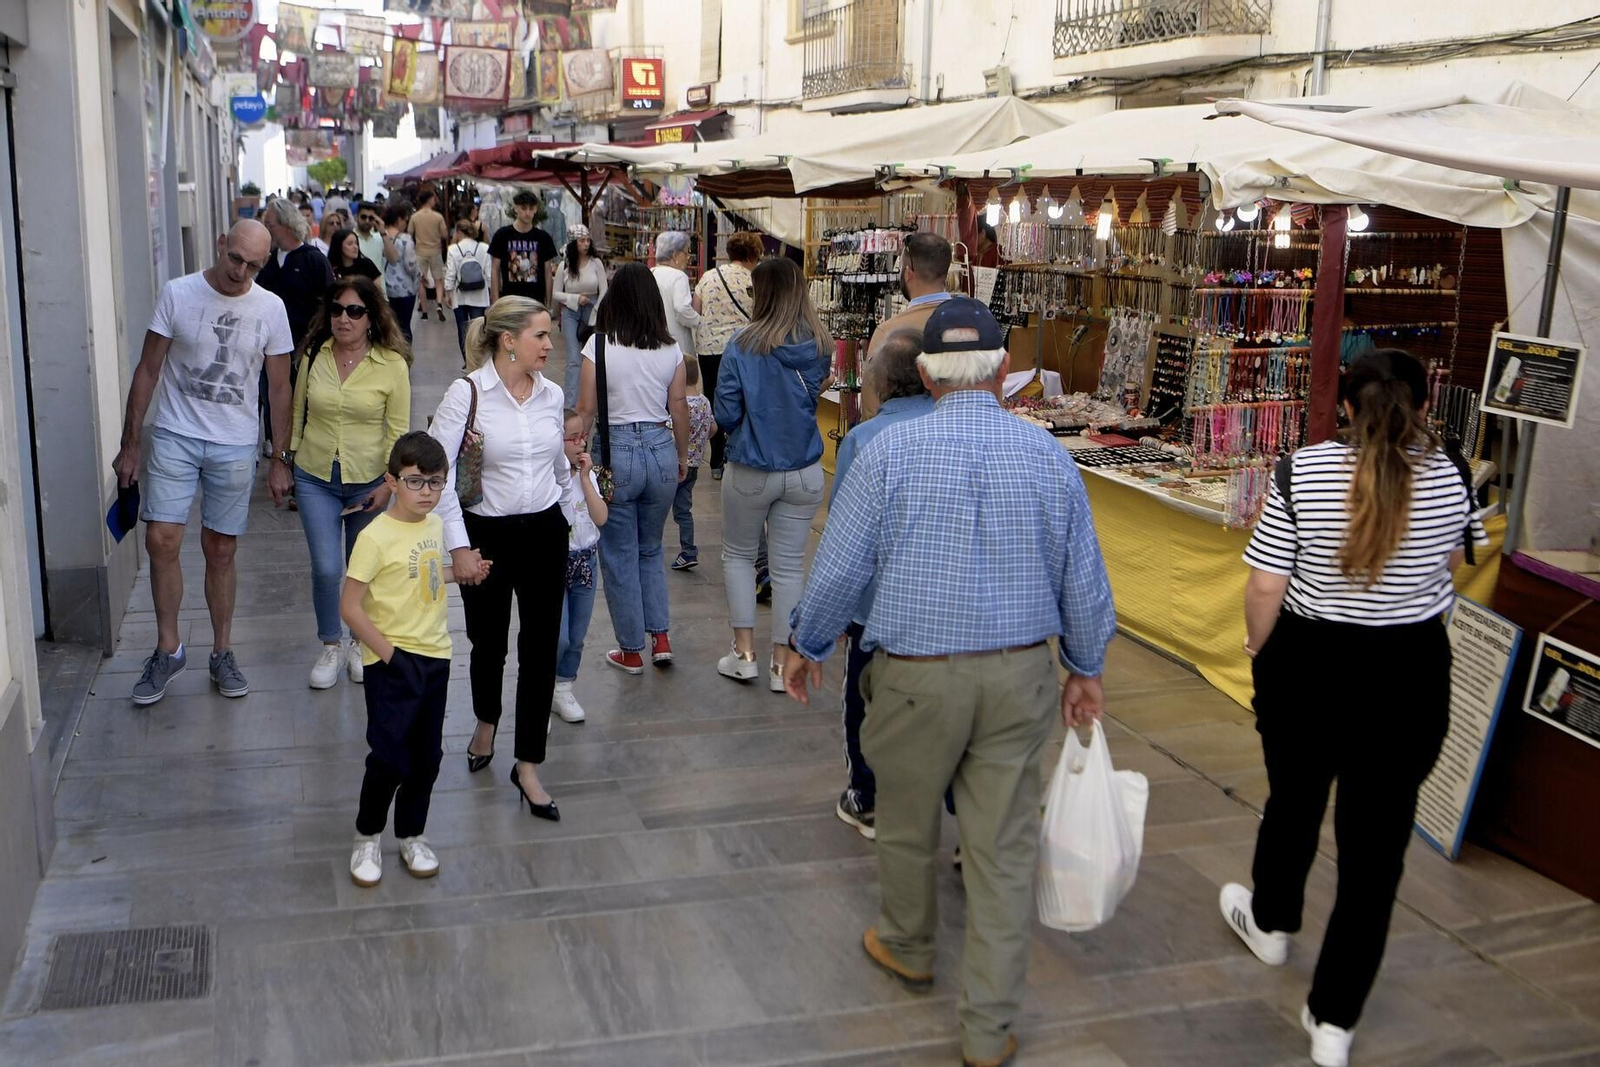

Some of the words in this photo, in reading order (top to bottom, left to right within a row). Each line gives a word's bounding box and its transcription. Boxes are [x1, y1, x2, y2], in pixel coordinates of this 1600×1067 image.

[194, 8, 249, 19] Antonio
[627, 87, 661, 96] TABACOS
[233, 99, 264, 112] pelayo
[1497, 340, 1514, 351] GEL
[1527, 344, 1560, 358] DOLOR
[408, 548, 420, 579] MOTOR
[1452, 617, 1475, 635] ACEITE
[1474, 628, 1485, 641] DE
[1458, 602, 1501, 634] PROPIEDADES
[1500, 625, 1514, 640] DEL
